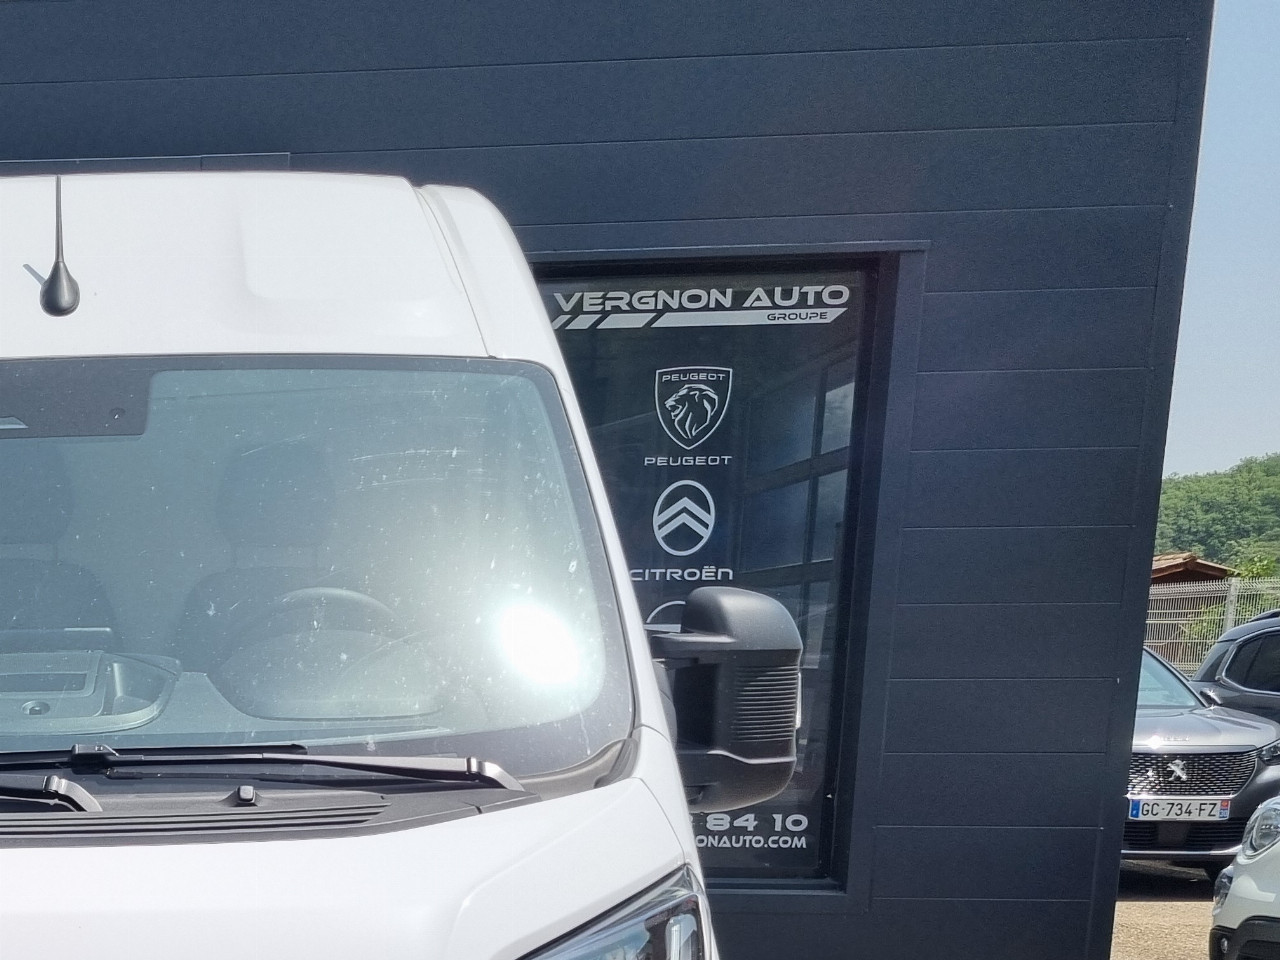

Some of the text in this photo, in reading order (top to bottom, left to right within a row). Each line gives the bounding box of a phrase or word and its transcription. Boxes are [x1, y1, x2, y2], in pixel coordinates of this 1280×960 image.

[553, 284, 850, 312] VERGNON AUTO
[767, 311, 828, 321] GROUPE
[661, 373, 726, 382] PEUGEOT
[644, 456, 732, 466] PEUGEOT
[1141, 803, 1217, 817] GC-734-FZ
[706, 813, 758, 831] 84
[772, 813, 808, 832] 10
